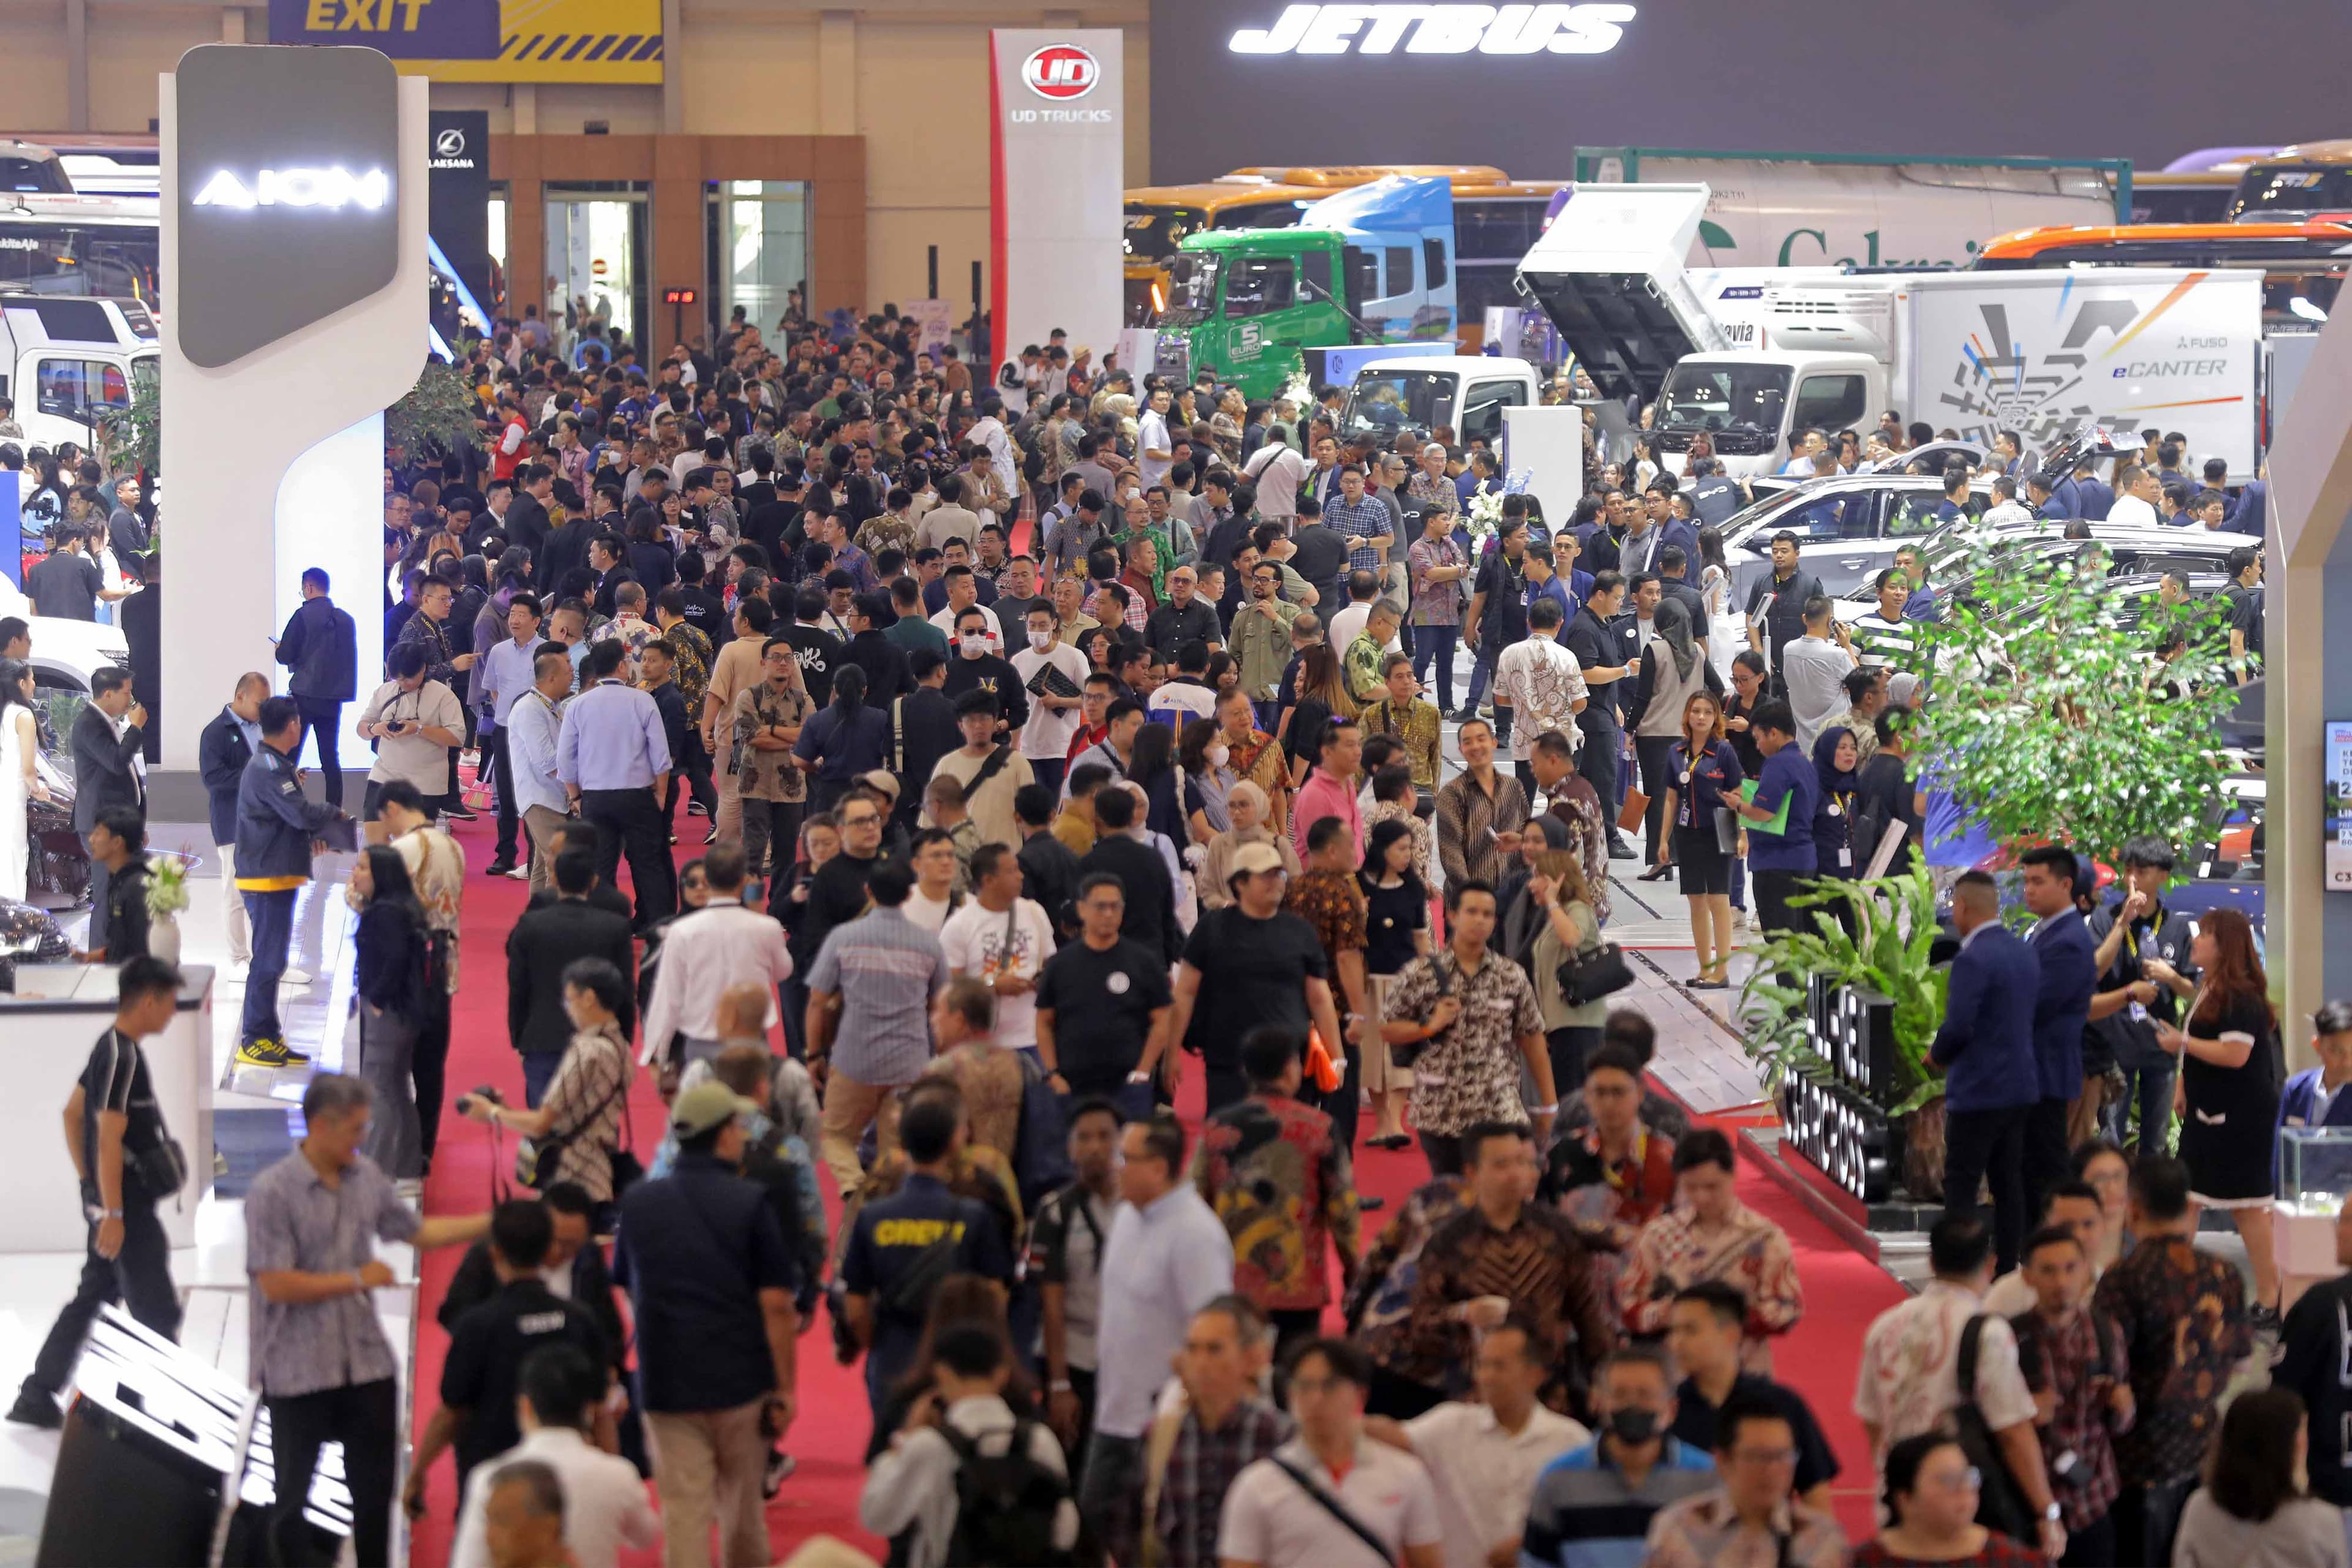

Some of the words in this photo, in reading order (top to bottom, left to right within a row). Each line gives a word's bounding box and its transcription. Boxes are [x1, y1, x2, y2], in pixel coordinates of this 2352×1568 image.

[305, 0, 431, 31] EXIT
[1228, 4, 1637, 55] JETBUS
[1030, 58, 1095, 86] UD
[1011, 109, 1037, 123] UD
[1040, 109, 1112, 123] TRUCKS
[428, 158, 474, 168] LAKSANA
[192, 167, 385, 207] AION
[1242, 325, 1259, 345] 5
[1724, 320, 1754, 342] avia
[1231, 343, 1261, 355] EURO
[2190, 337, 2228, 349] FUSO
[2113, 359, 2228, 379] eCANTER
